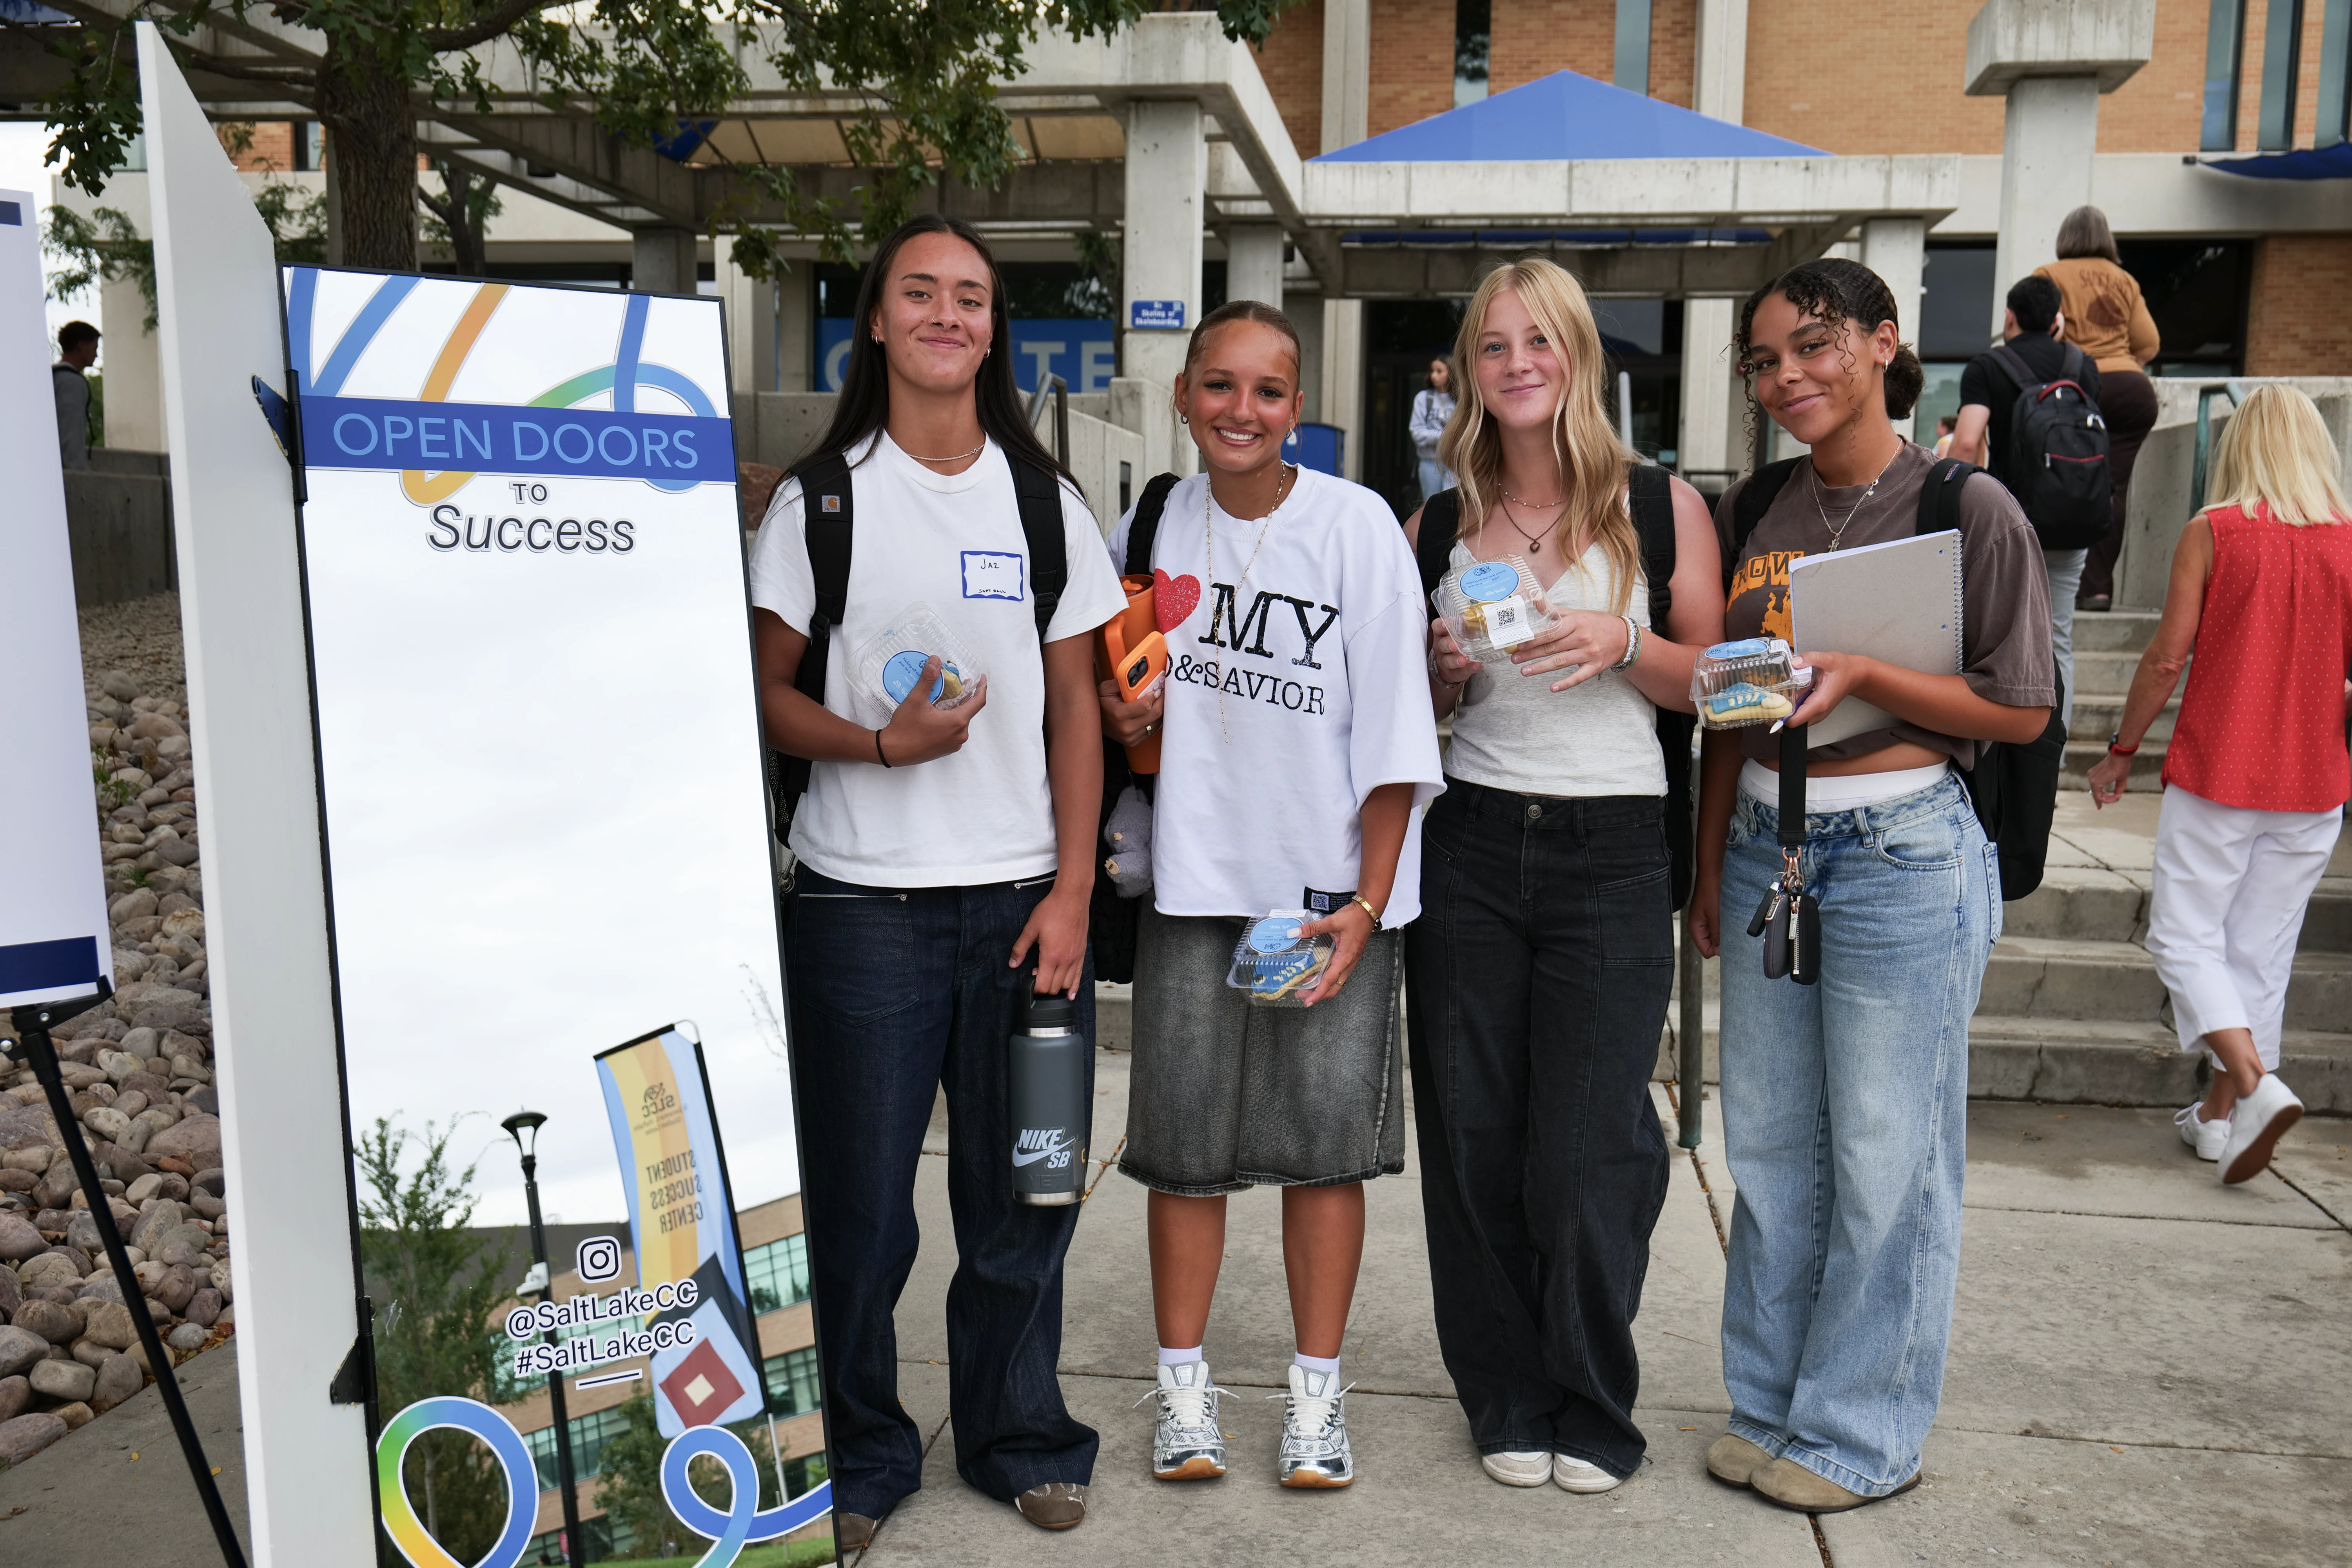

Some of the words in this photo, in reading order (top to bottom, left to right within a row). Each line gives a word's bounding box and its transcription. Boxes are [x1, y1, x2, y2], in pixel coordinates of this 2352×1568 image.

[333, 413, 492, 460] OPEN
[513, 421, 698, 470] DOORS
[513, 482, 548, 503] TO
[428, 505, 635, 552] Success
[980, 558, 1000, 569] JAZ
[1198, 583, 1339, 670] MY
[902, 657, 913, 669] Kicking
[1018, 1129, 1063, 1150] NIKE
[1047, 1151, 1071, 1169] SB
[1027, 1173, 1070, 1188] YETI
[508, 1280, 695, 1338] @SaltLakeCC
[517, 1323, 694, 1373] #SaltLakeCC
